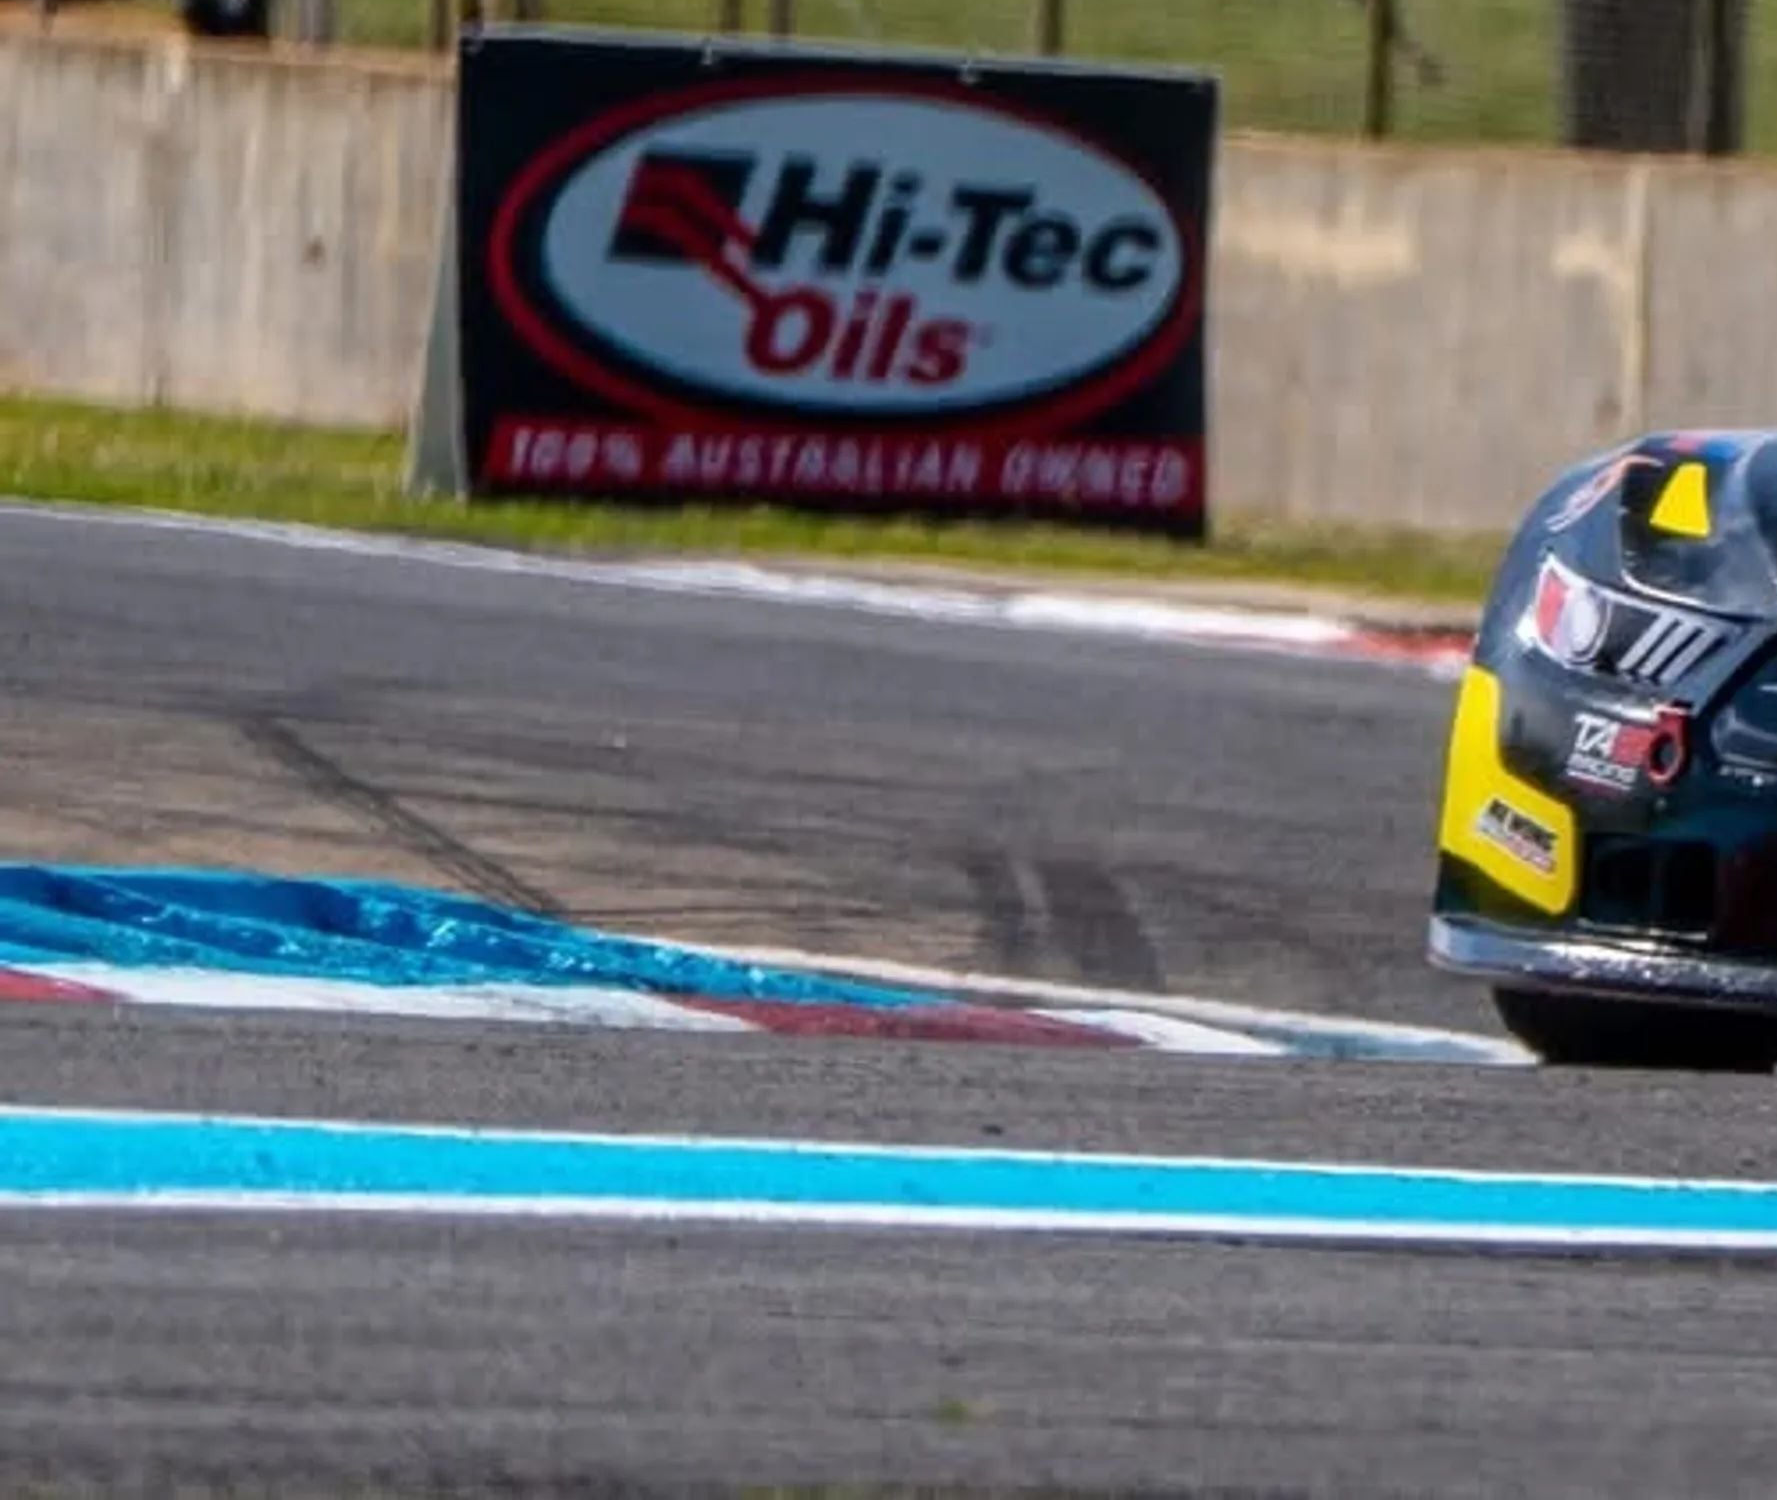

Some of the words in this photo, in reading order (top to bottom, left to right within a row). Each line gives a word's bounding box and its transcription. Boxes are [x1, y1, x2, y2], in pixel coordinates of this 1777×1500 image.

[753, 151, 1160, 290] Hi-Tec
[744, 286, 971, 385] Oils
[509, 426, 644, 479] 100%
[664, 433, 981, 494] AUSTRALIAN
[1001, 442, 1187, 500] OWNED
